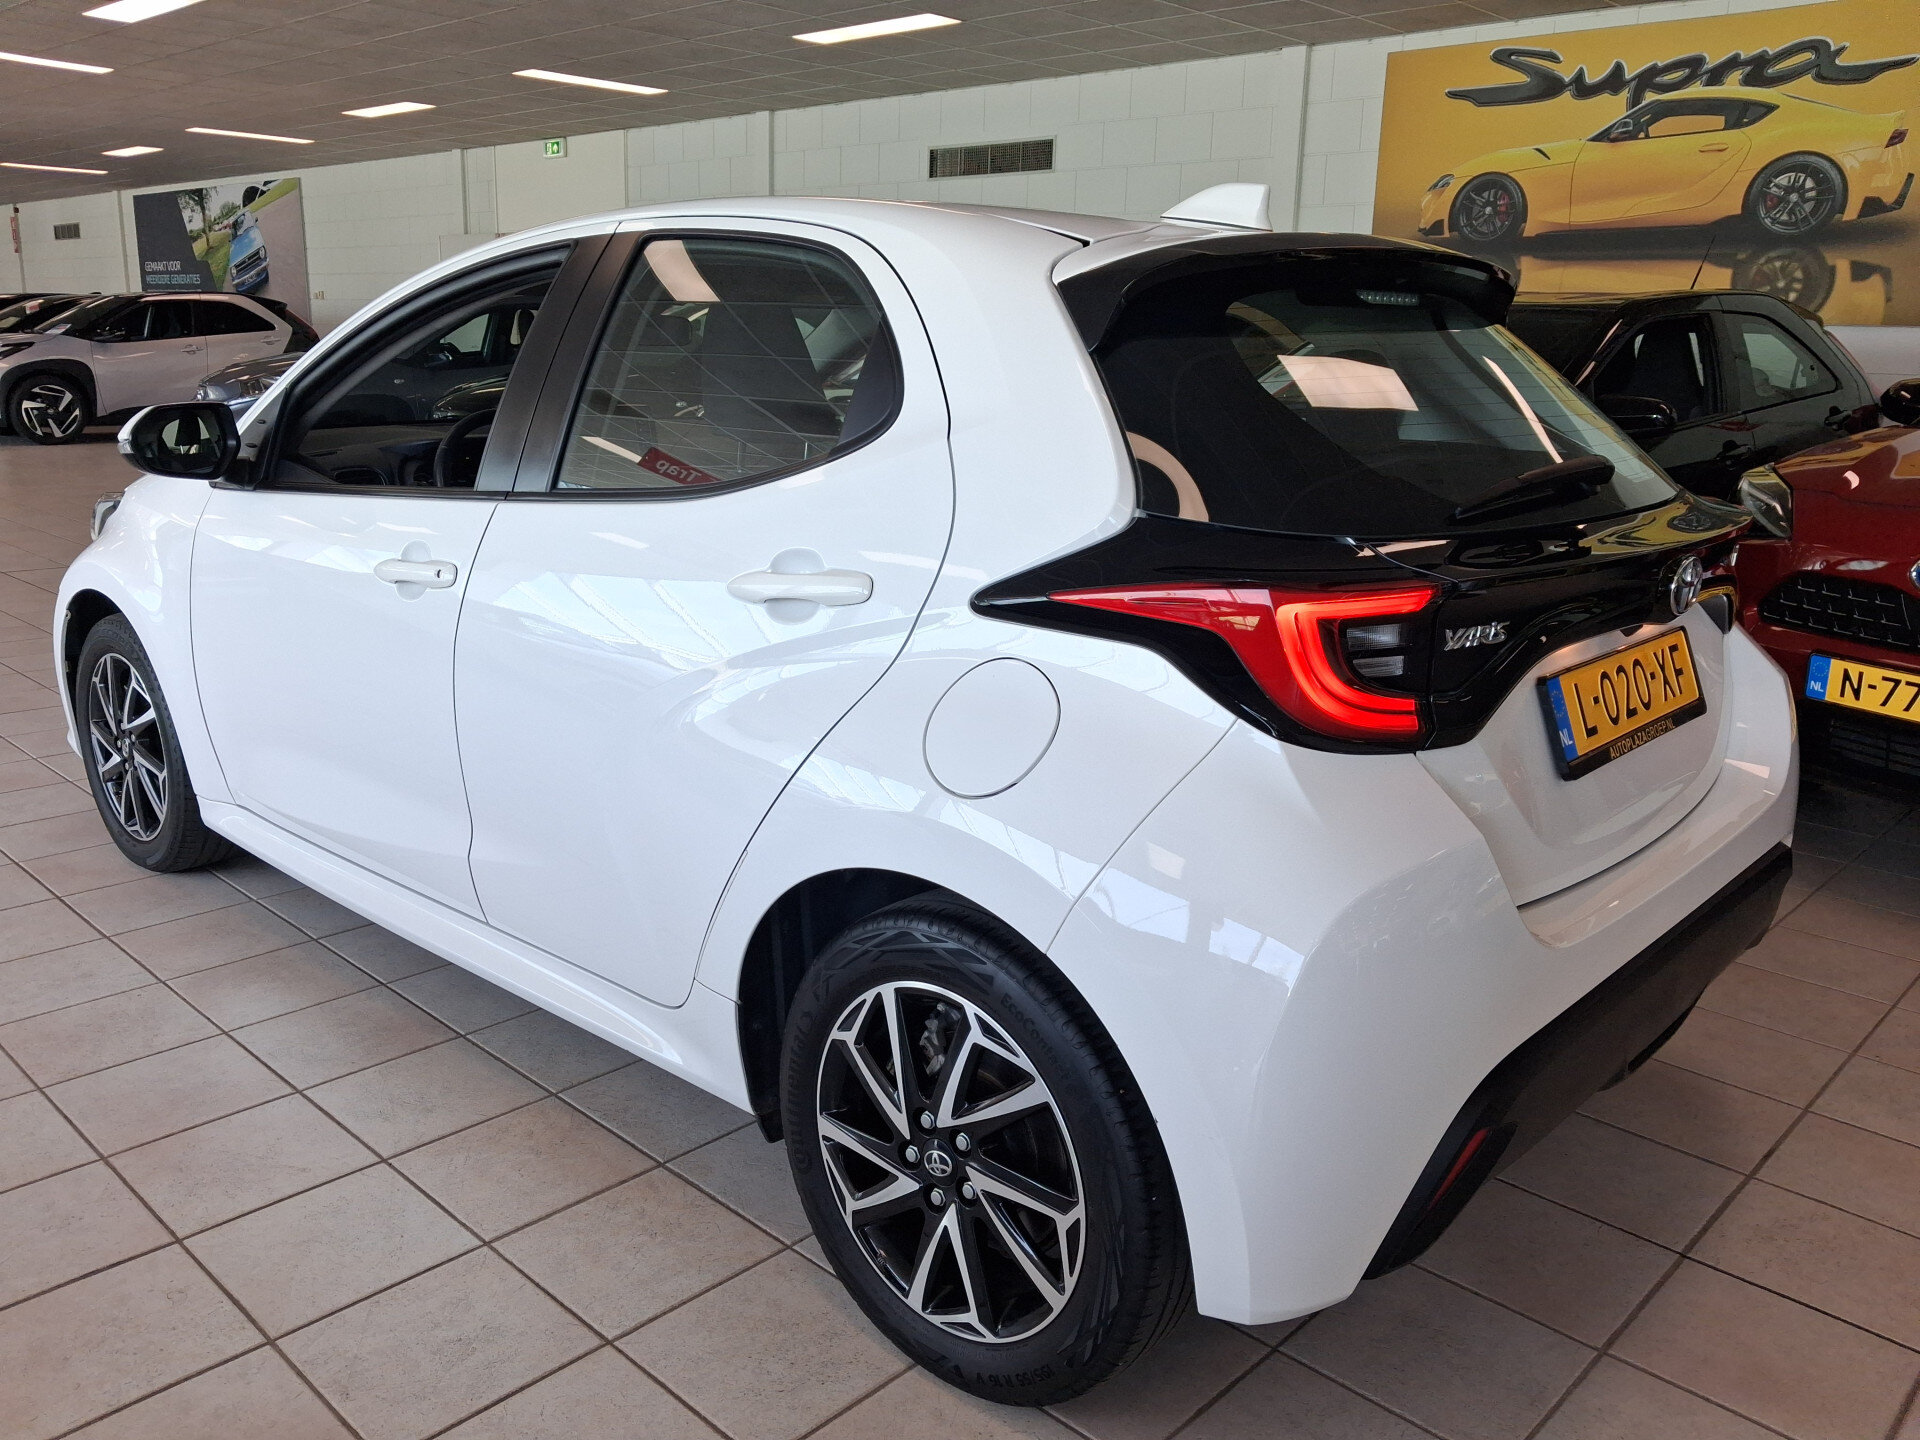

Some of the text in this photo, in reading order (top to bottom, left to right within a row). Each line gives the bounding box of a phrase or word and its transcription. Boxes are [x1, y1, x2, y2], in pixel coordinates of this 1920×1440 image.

[1444, 36, 1919, 112] Supra
[167, 260, 181, 271] VOOR
[1443, 621, 1510, 651] YARIS
[1573, 643, 1684, 739] L-020-XF
[1809, 680, 1824, 692] NL
[1559, 728, 1573, 748] NL
[1610, 718, 1676, 760] AUTOPLAZAGROEP.NL
